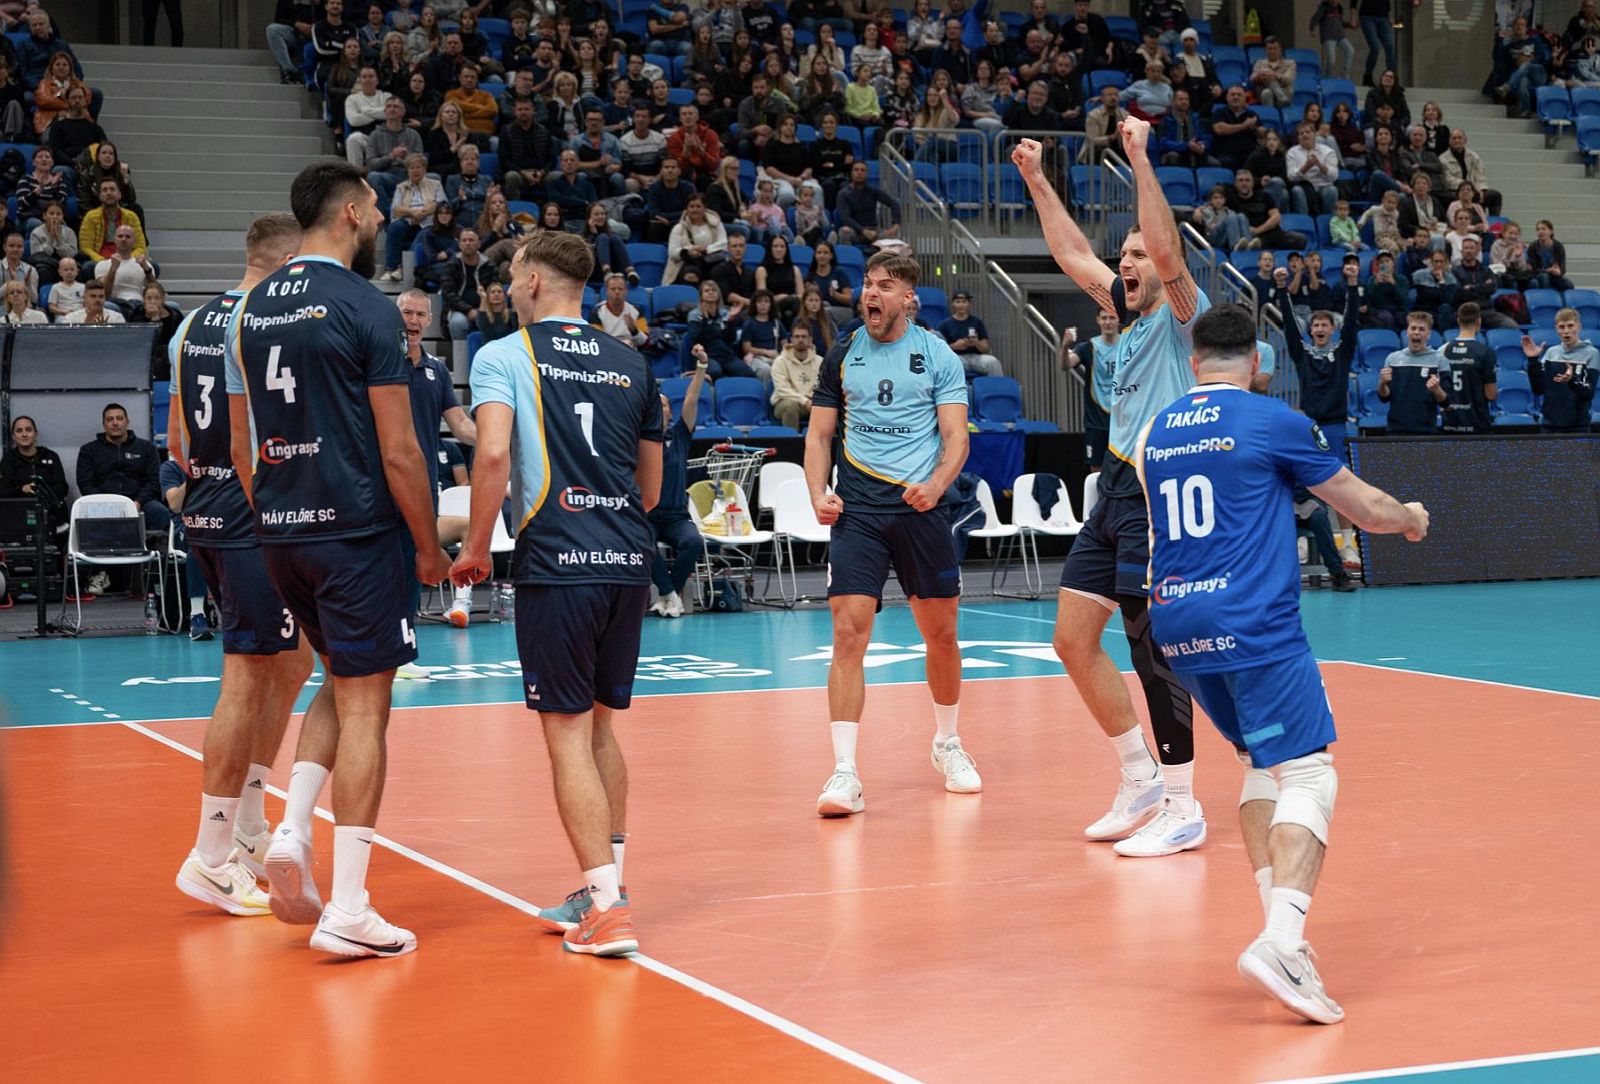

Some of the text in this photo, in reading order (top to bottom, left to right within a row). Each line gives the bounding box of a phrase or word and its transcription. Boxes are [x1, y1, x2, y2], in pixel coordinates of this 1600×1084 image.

[266, 279, 310, 297] KOCI
[243, 304, 328, 331] TippmixPRO
[183, 340, 225, 357] TippmixP
[552, 336, 600, 356] SZABÓ
[265, 345, 297, 404] 4
[537, 363, 632, 389] TippmixPRO
[1453, 370, 1463, 391] 5
[194, 374, 216, 431] 3
[877, 378, 894, 407] 8
[574, 401, 601, 458] 1
[1165, 405, 1222, 430] TAKÁCS
[1145, 436, 1236, 463] TippmixPRO
[262, 508, 285, 526] MÁV
[318, 508, 336, 522] SC
[1159, 474, 1216, 542] 10
[209, 517, 224, 529] SC
[558, 548, 644, 566] MÁV ELŐRE SC
[1160, 577, 1228, 599] ingrasys
[280, 608, 295, 639] 3
[400, 617, 416, 649] 4
[1179, 637, 1216, 656] ELŐRE
[1215, 635, 1237, 652] SC
